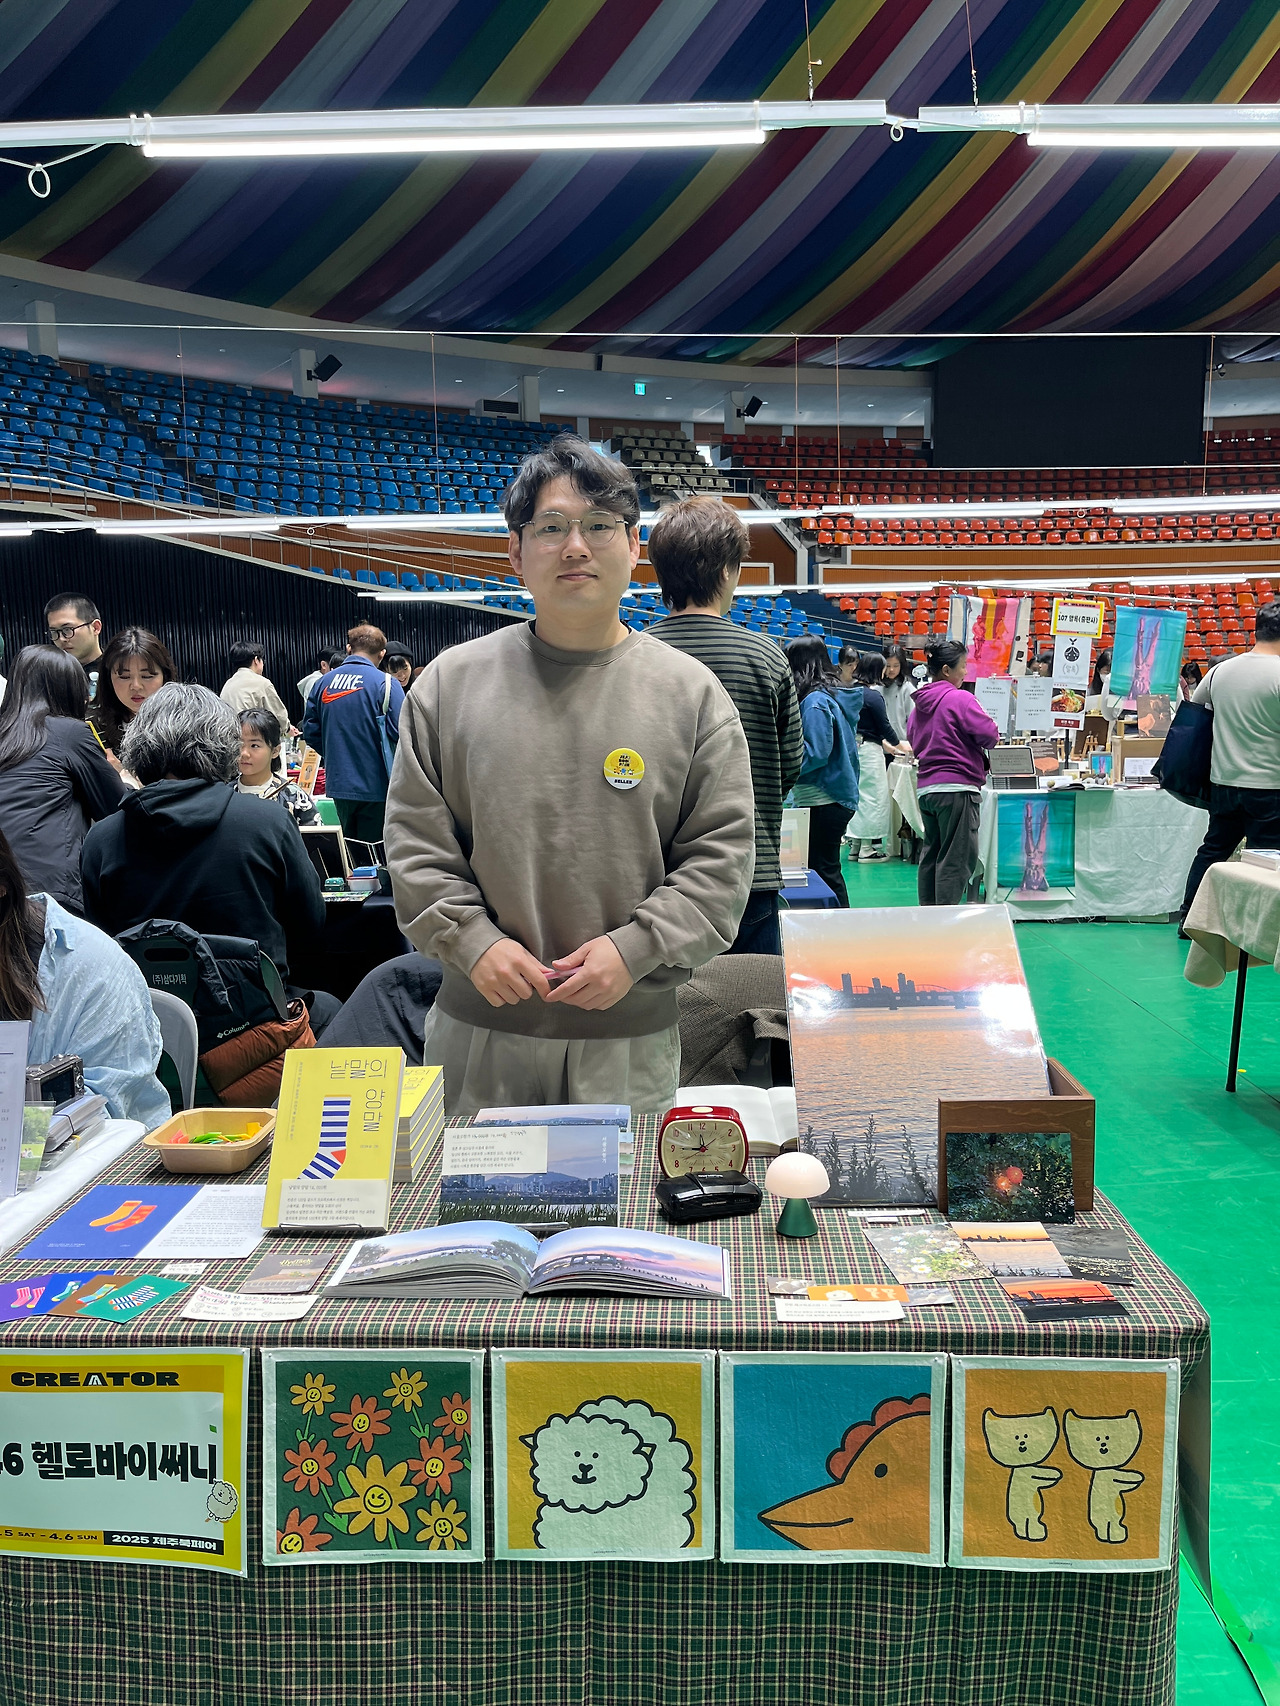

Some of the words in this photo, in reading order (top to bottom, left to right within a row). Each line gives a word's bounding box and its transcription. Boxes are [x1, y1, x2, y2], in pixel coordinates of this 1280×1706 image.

[329, 673, 363, 690] NIKE
[223, 1021, 250, 1036] Columa
[330, 1059, 388, 1080] 낱말의
[363, 1088, 386, 1132] 양말
[687, 1123, 693, 1131] 11
[699, 1122, 706, 1131] 12
[714, 1122, 717, 1131] 1
[727, 1129, 733, 1137] 2
[670, 1144, 676, 1152] 9
[731, 1144, 736, 1153] 3
[674, 1159, 680, 1168] 8
[728, 1159, 733, 1168] 4
[11, 1371, 180, 1388] CREATOR
[0, 1442, 24, 1476] 6
[31, 1441, 217, 1485] 헬로바이써니
[49, 1533, 74, 1541] 4.6
[111, 1534, 150, 1545] 2025
[152, 1536, 217, 1551] 제주북페어
